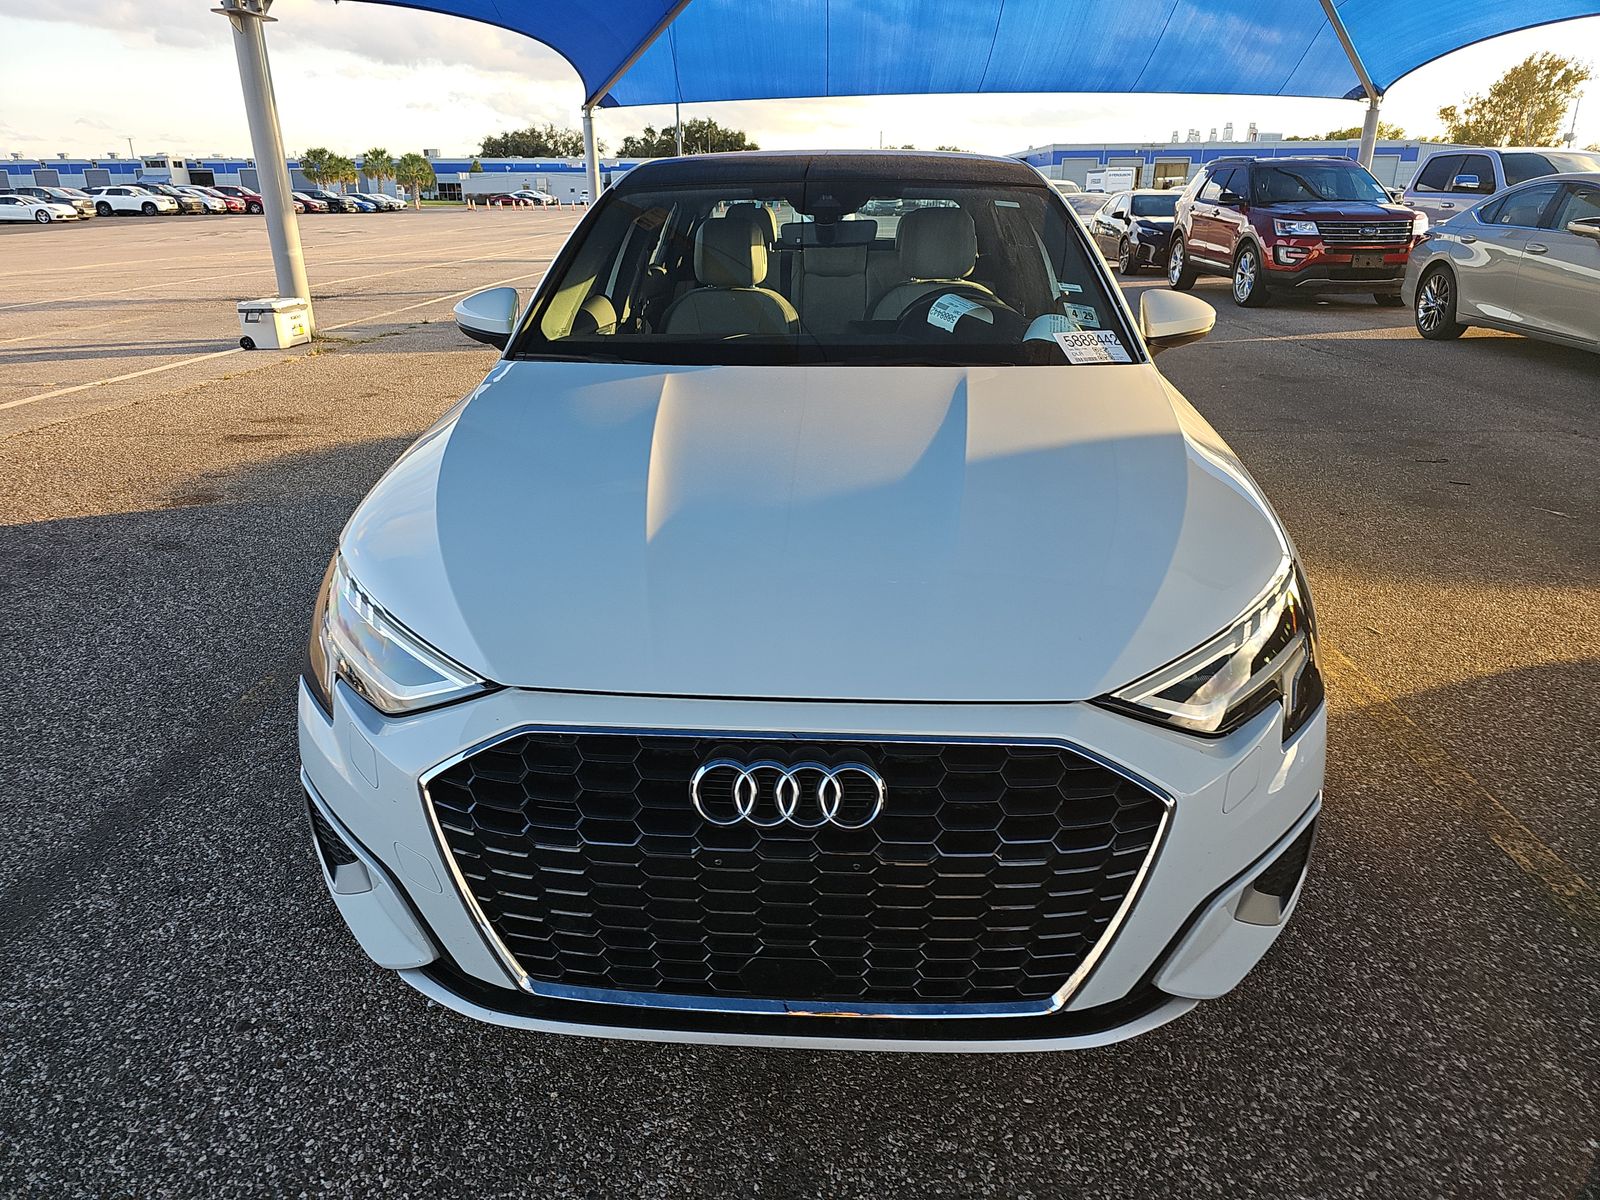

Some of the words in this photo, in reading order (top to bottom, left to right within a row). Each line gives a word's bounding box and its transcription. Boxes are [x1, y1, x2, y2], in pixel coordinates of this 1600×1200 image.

[1072, 310, 1078, 318] 4
[1083, 311, 1094, 320] 29
[1063, 333, 1122, 347] 5888442
